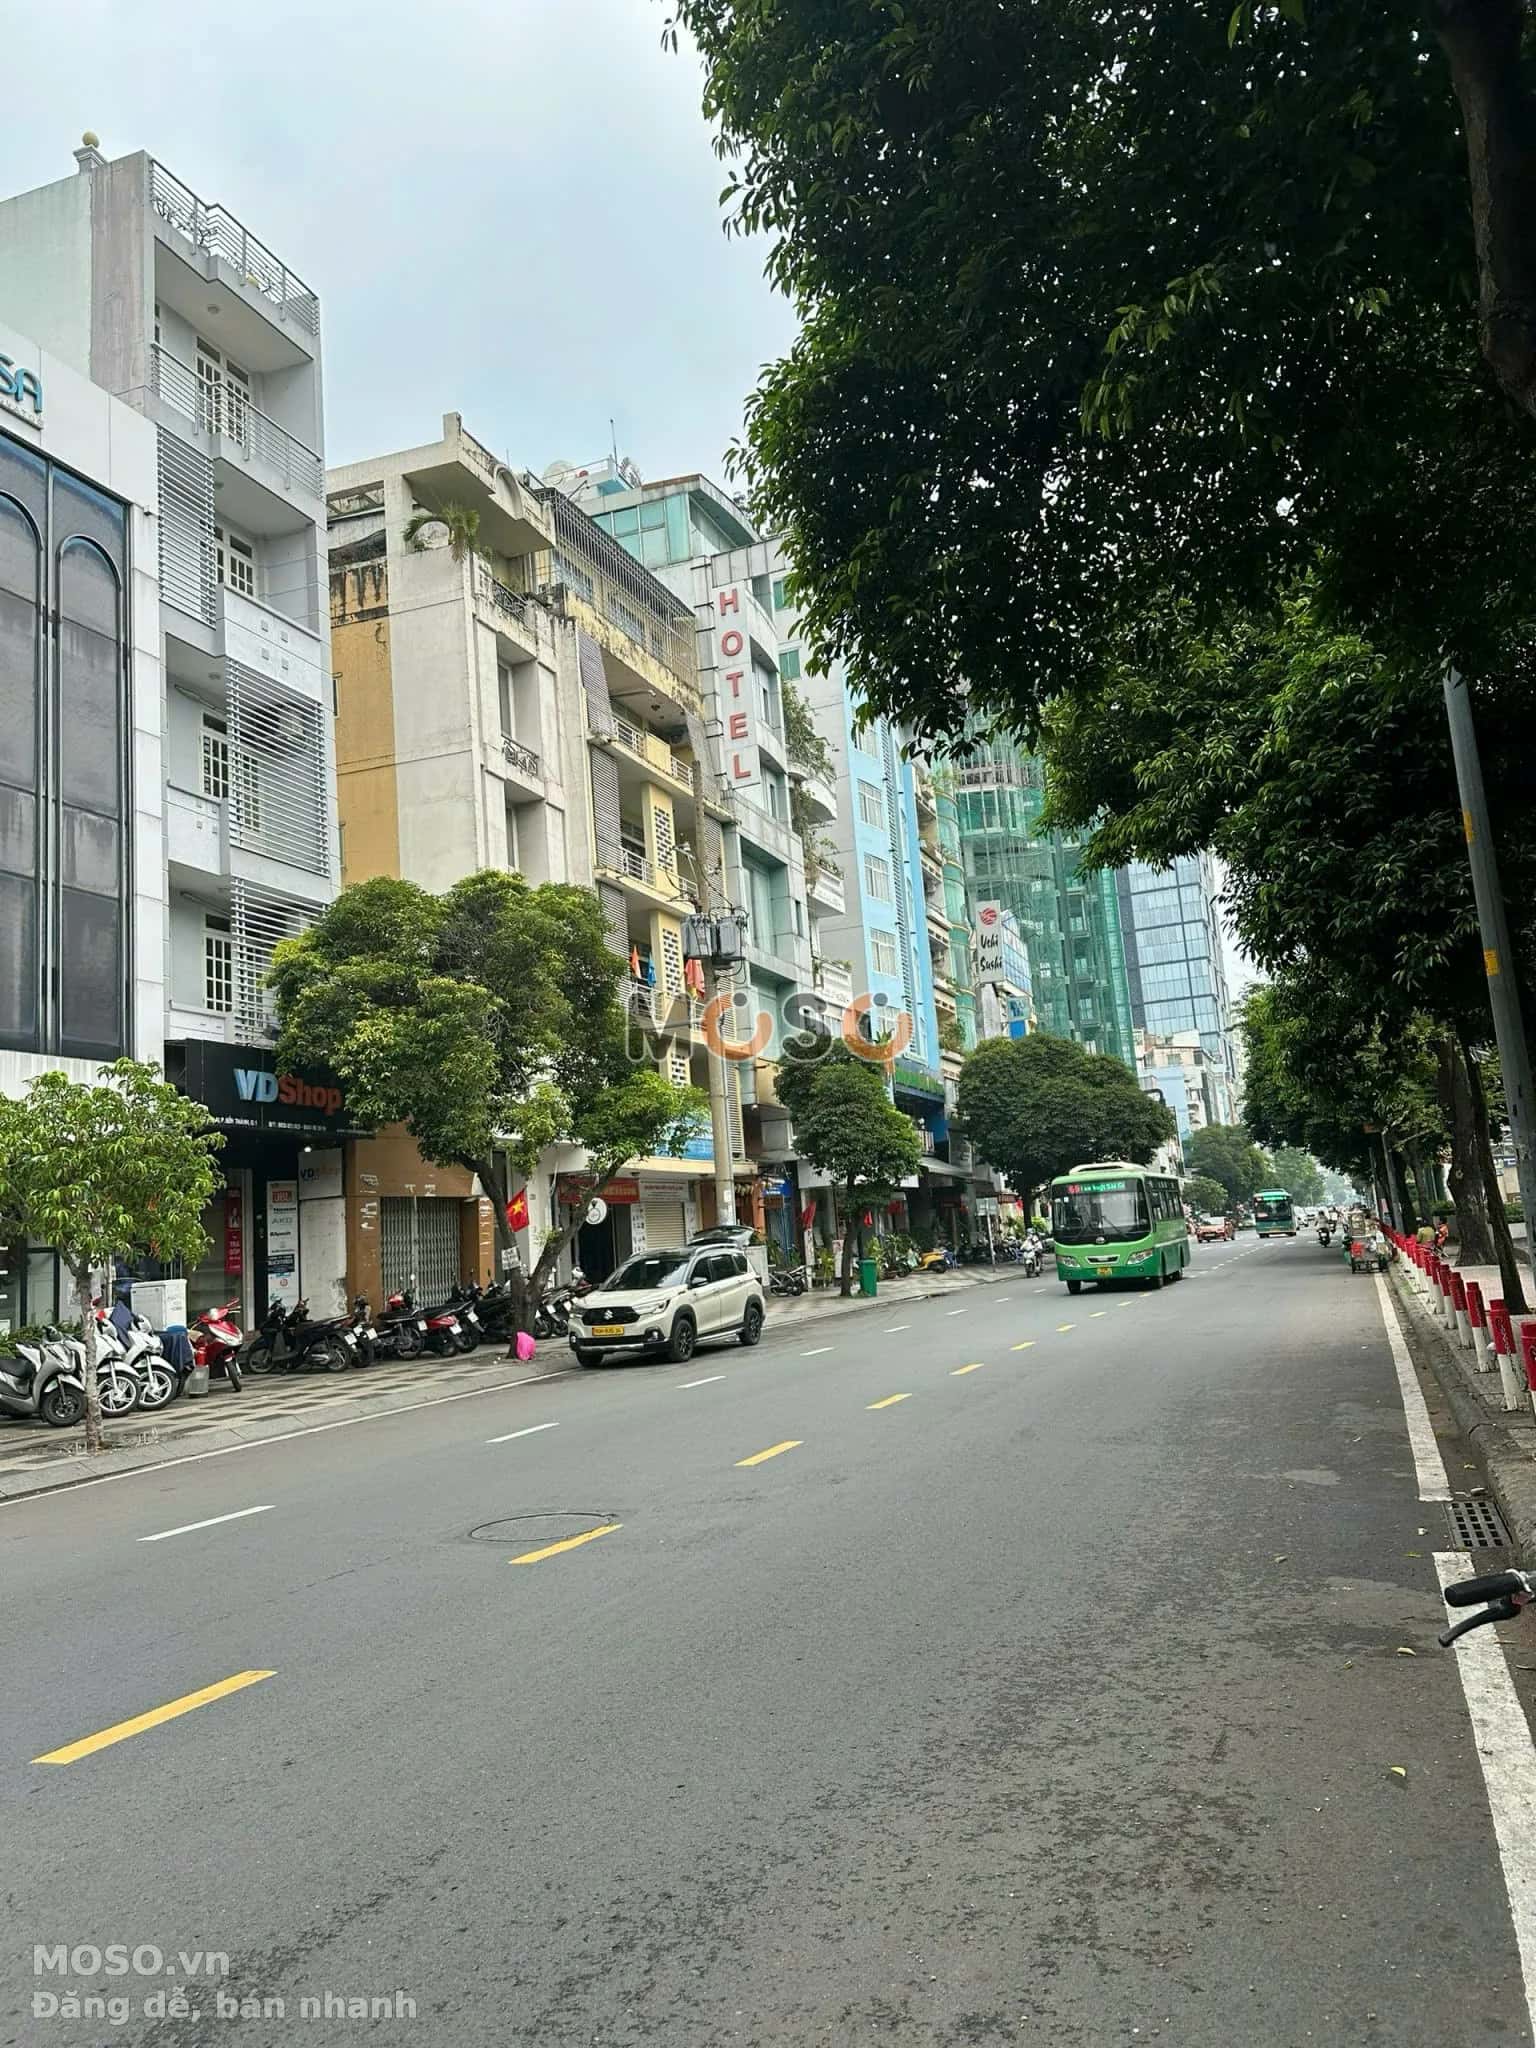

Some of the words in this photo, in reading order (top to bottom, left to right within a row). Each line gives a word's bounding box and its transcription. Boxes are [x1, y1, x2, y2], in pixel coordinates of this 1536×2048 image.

[719, 588, 751, 780] HOTEL
[980, 956, 1003, 972] Sushi
[233, 1068, 343, 1116] VDShop
